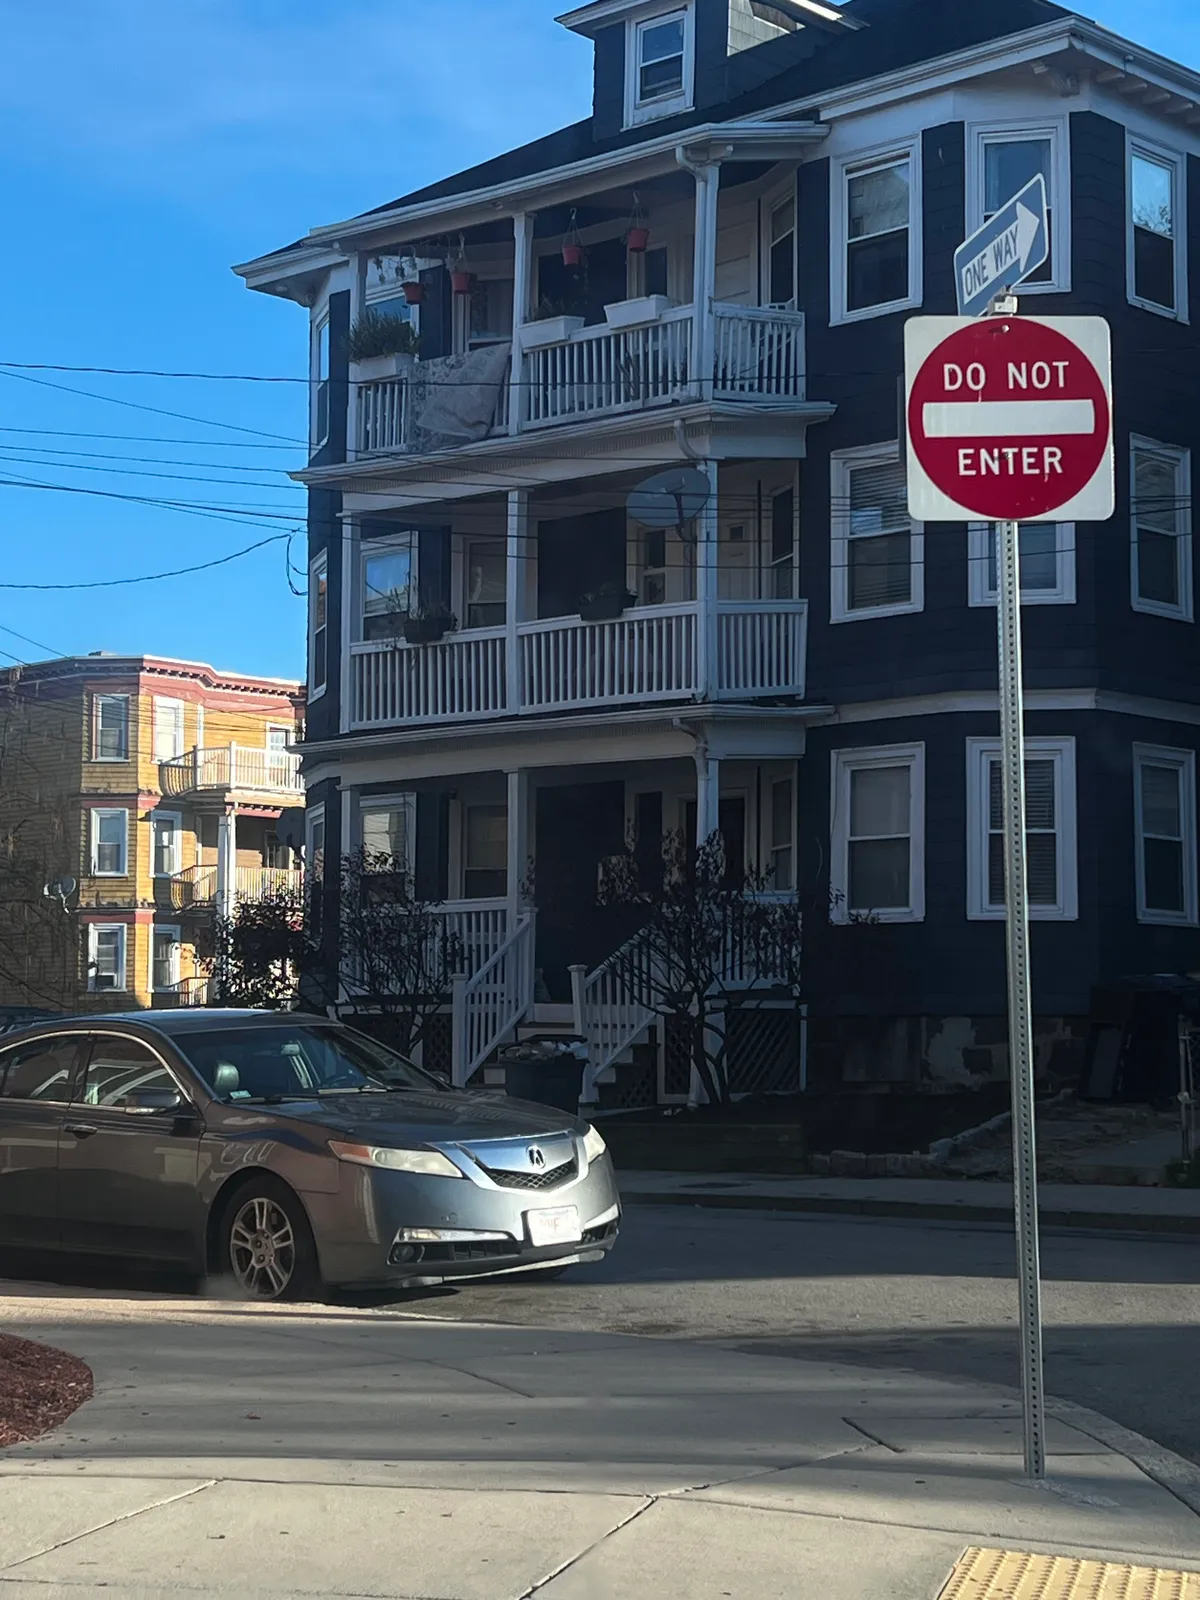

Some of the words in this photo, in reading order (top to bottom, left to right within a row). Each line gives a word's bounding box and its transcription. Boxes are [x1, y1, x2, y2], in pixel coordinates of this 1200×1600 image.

[964, 253, 990, 297] ONE
[992, 224, 1019, 273] WAY
[943, 362, 986, 391] DO
[1007, 361, 1070, 390] NOT
[957, 446, 1063, 476] ENTER
